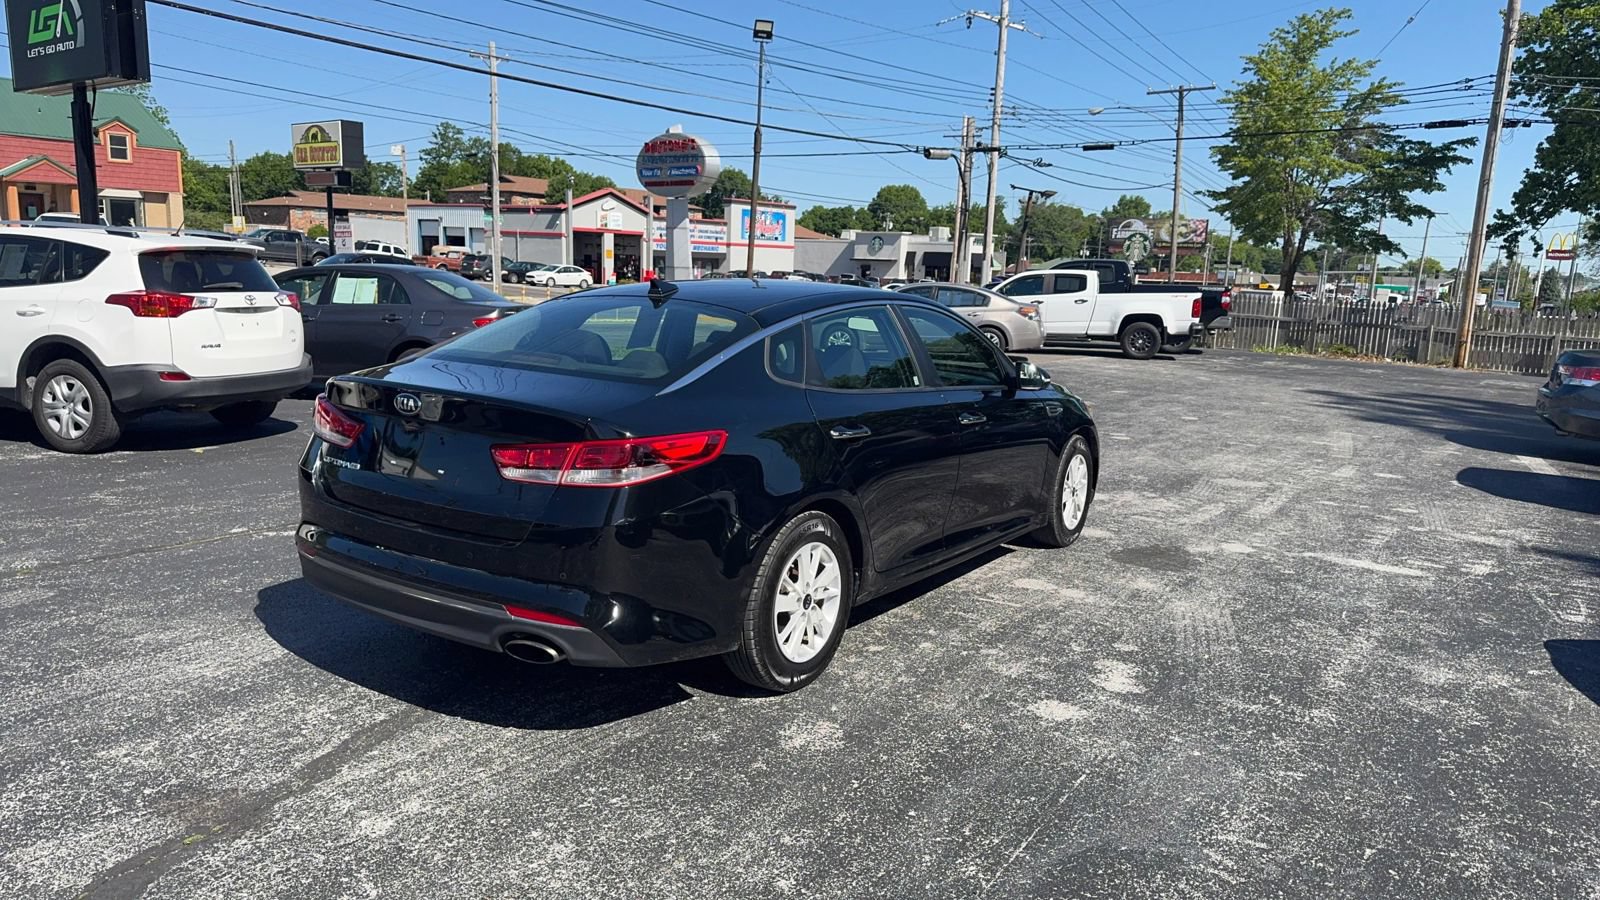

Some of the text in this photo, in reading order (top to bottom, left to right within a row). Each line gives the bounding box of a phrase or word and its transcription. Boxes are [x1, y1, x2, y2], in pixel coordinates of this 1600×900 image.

[27, 40, 75, 58] LET'S GO AUTO
[671, 167, 696, 176] Mechanic
[397, 396, 415, 410] KIA
